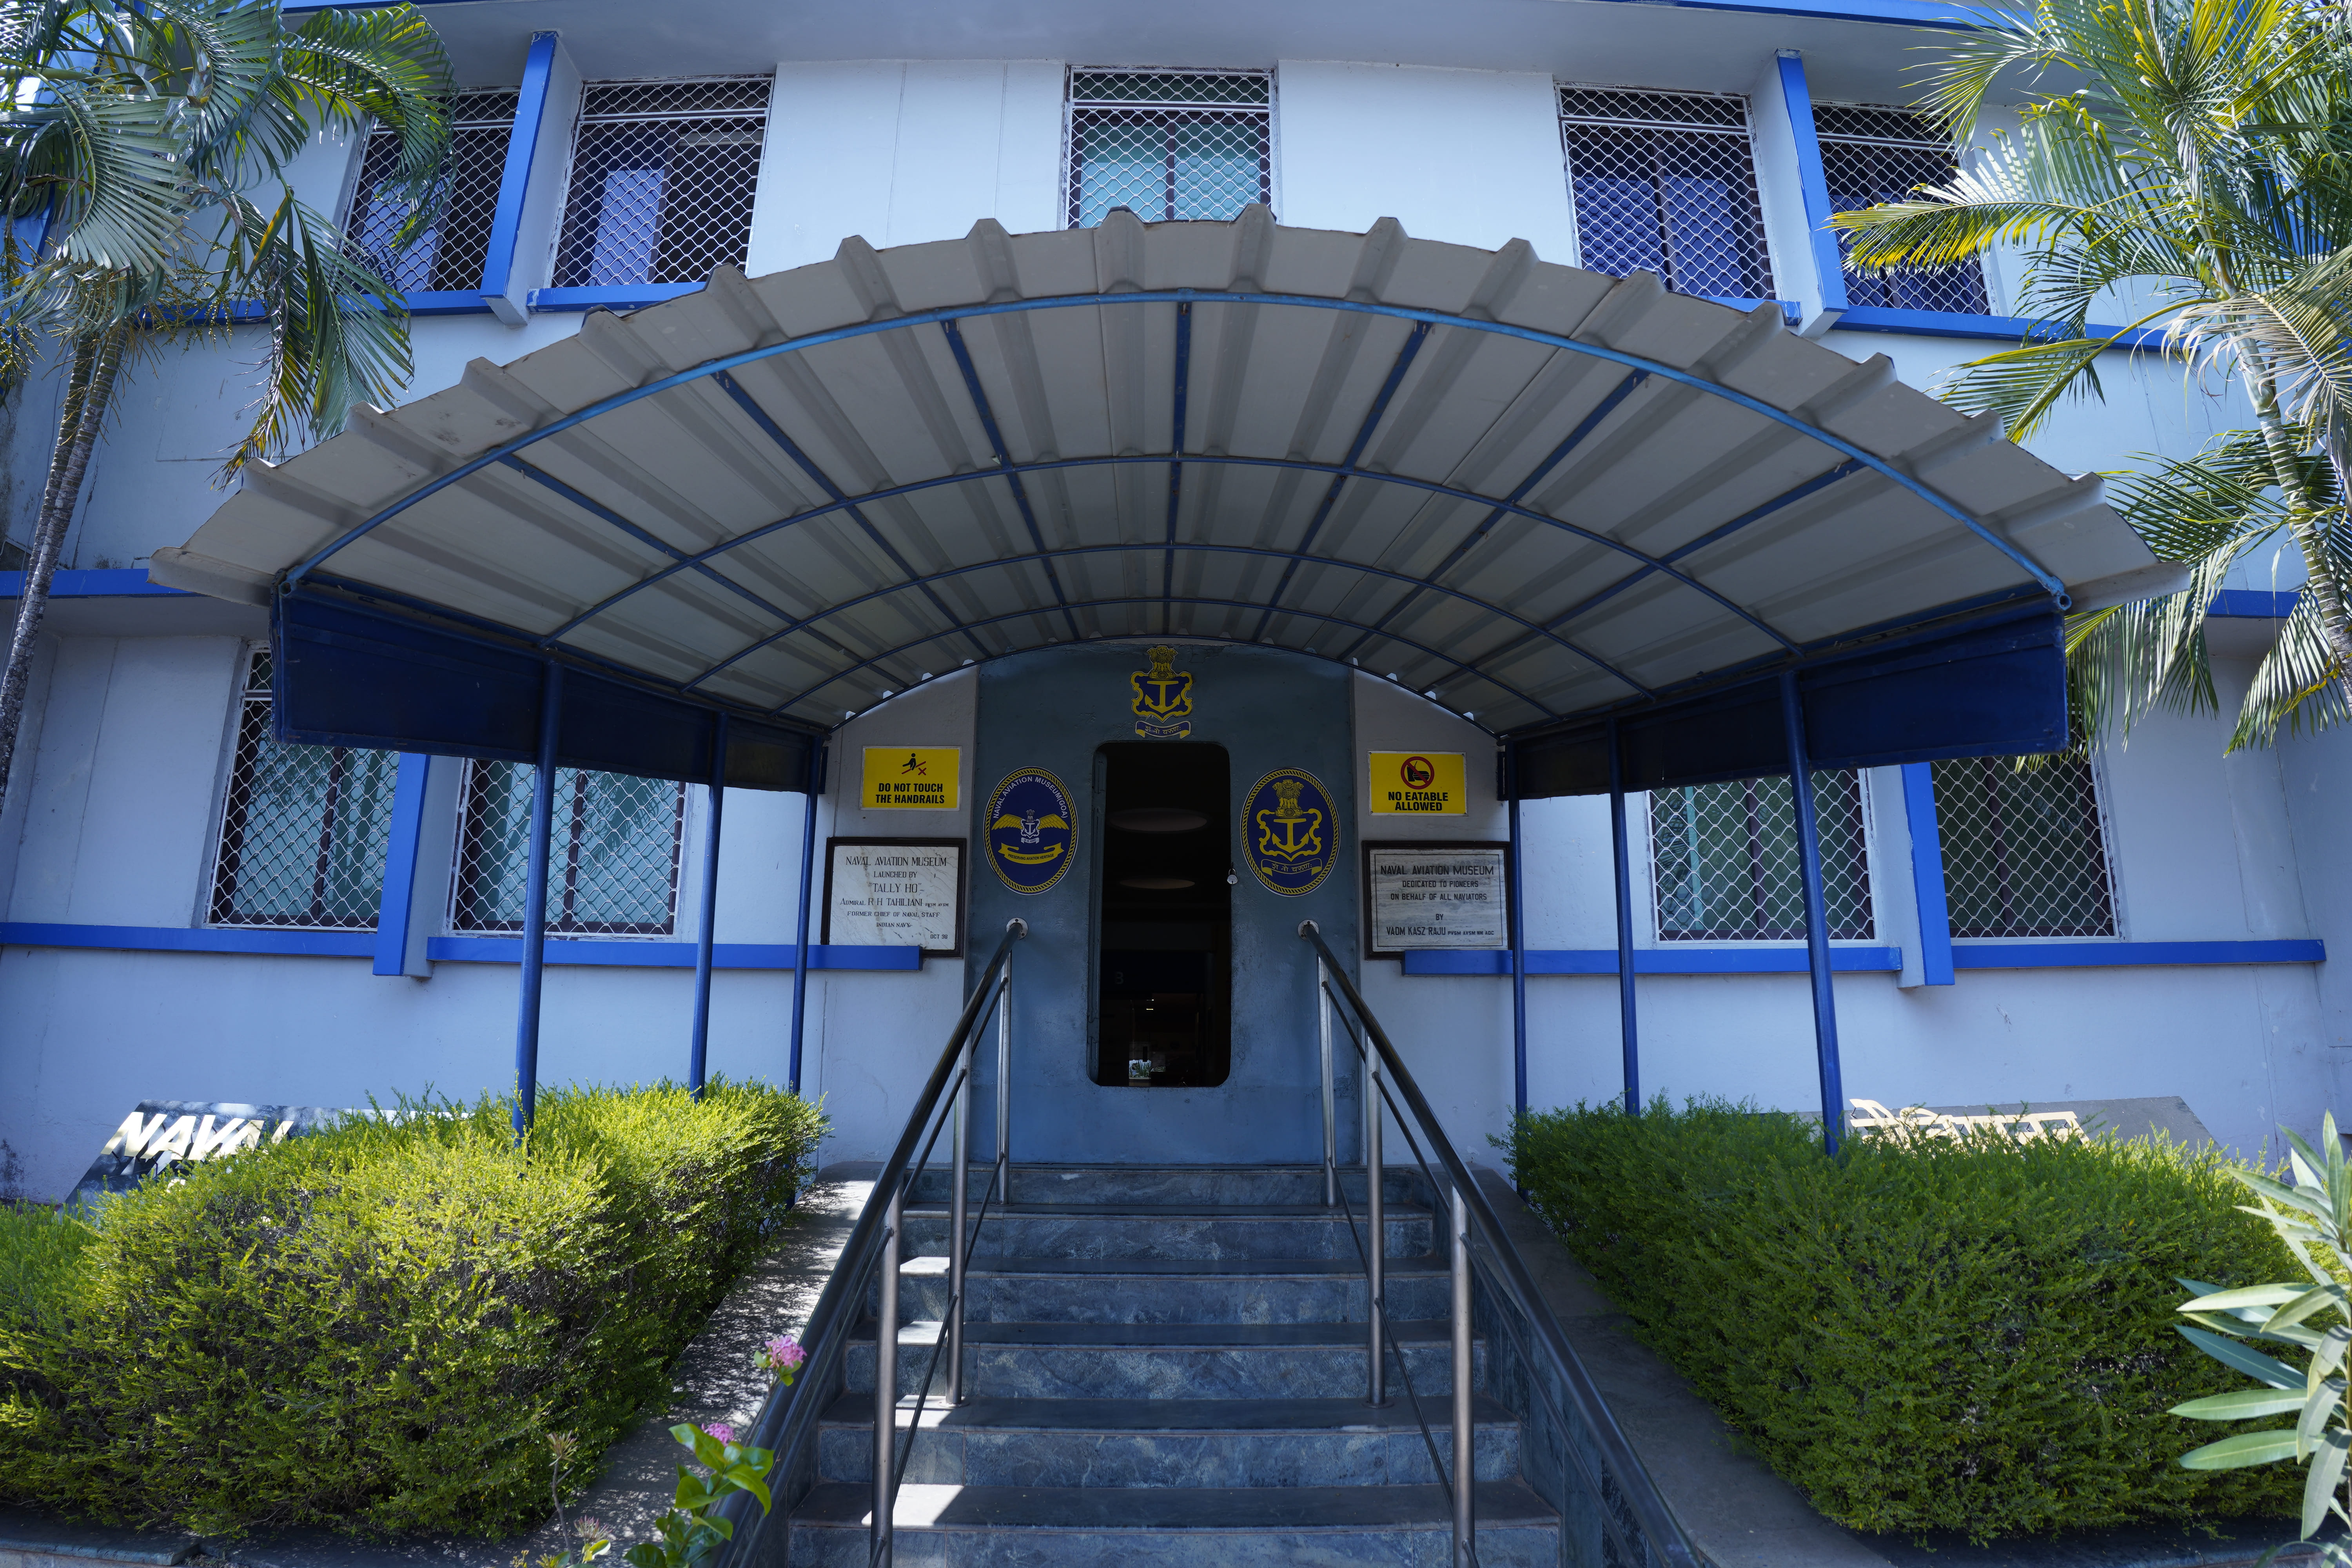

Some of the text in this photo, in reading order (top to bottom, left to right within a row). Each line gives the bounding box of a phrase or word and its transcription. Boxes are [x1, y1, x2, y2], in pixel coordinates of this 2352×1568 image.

[878, 783, 943, 792] DO NOT TOUCH
[876, 795, 944, 804] THE HANDRAILS
[993, 797, 1005, 818] NAVAL
[1002, 776, 1033, 797] AVIATION
[1388, 792, 1448, 801] NO EATABLE
[1395, 802, 1442, 811] ALLOWED
[846, 856, 947, 866] NAVAL AVIATION MUSEUM
[1381, 866, 1494, 875] NAVAL AVIATION MUSEUM
[1408, 927, 1426, 935] KASZ
[1428, 927, 1446, 935] RAJU
